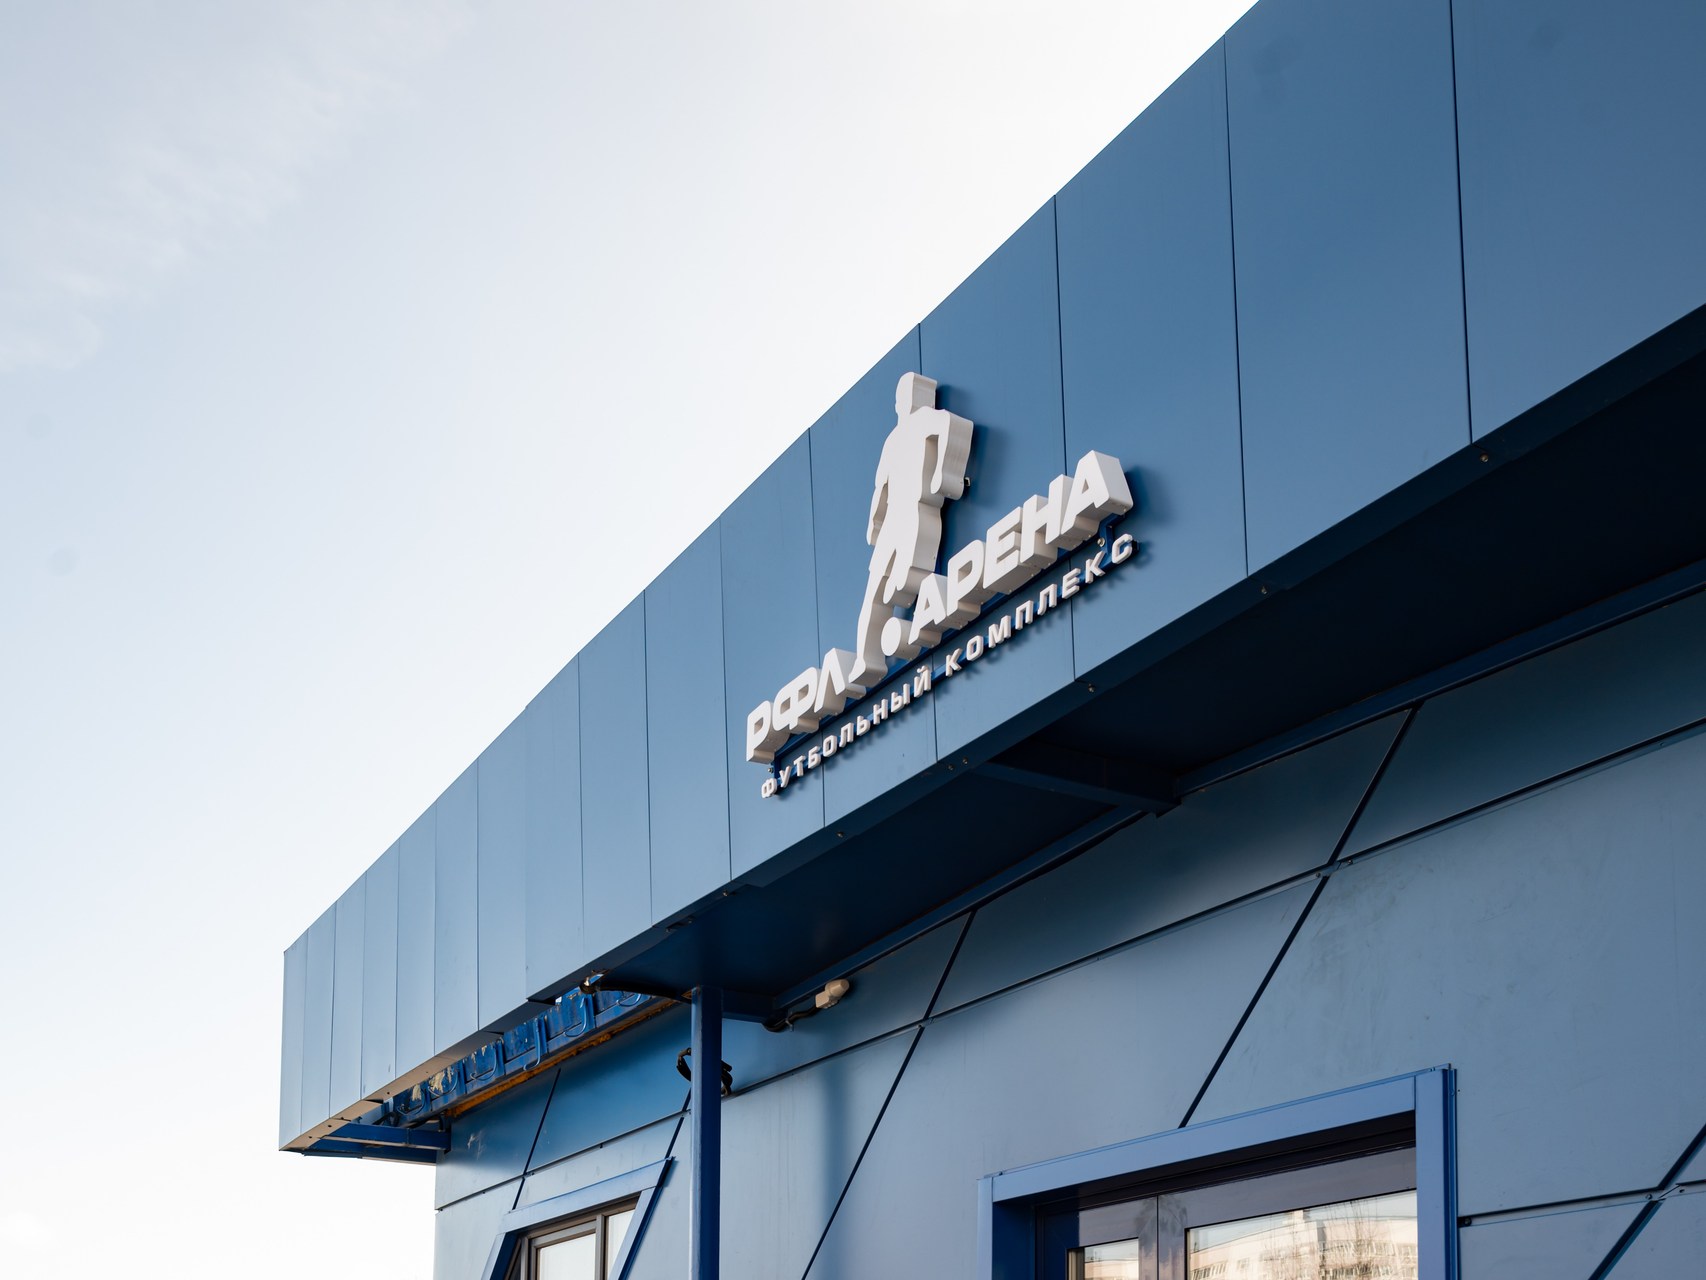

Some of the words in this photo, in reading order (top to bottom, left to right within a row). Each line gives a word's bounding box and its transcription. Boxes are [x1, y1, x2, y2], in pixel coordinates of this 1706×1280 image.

[746, 648, 850, 763] РФЛ
[908, 450, 1122, 647] АРЕНА
[761, 664, 933, 798] ФУТБОЛЬНЫЙ
[944, 533, 1136, 677] КОМПЛЕКС
